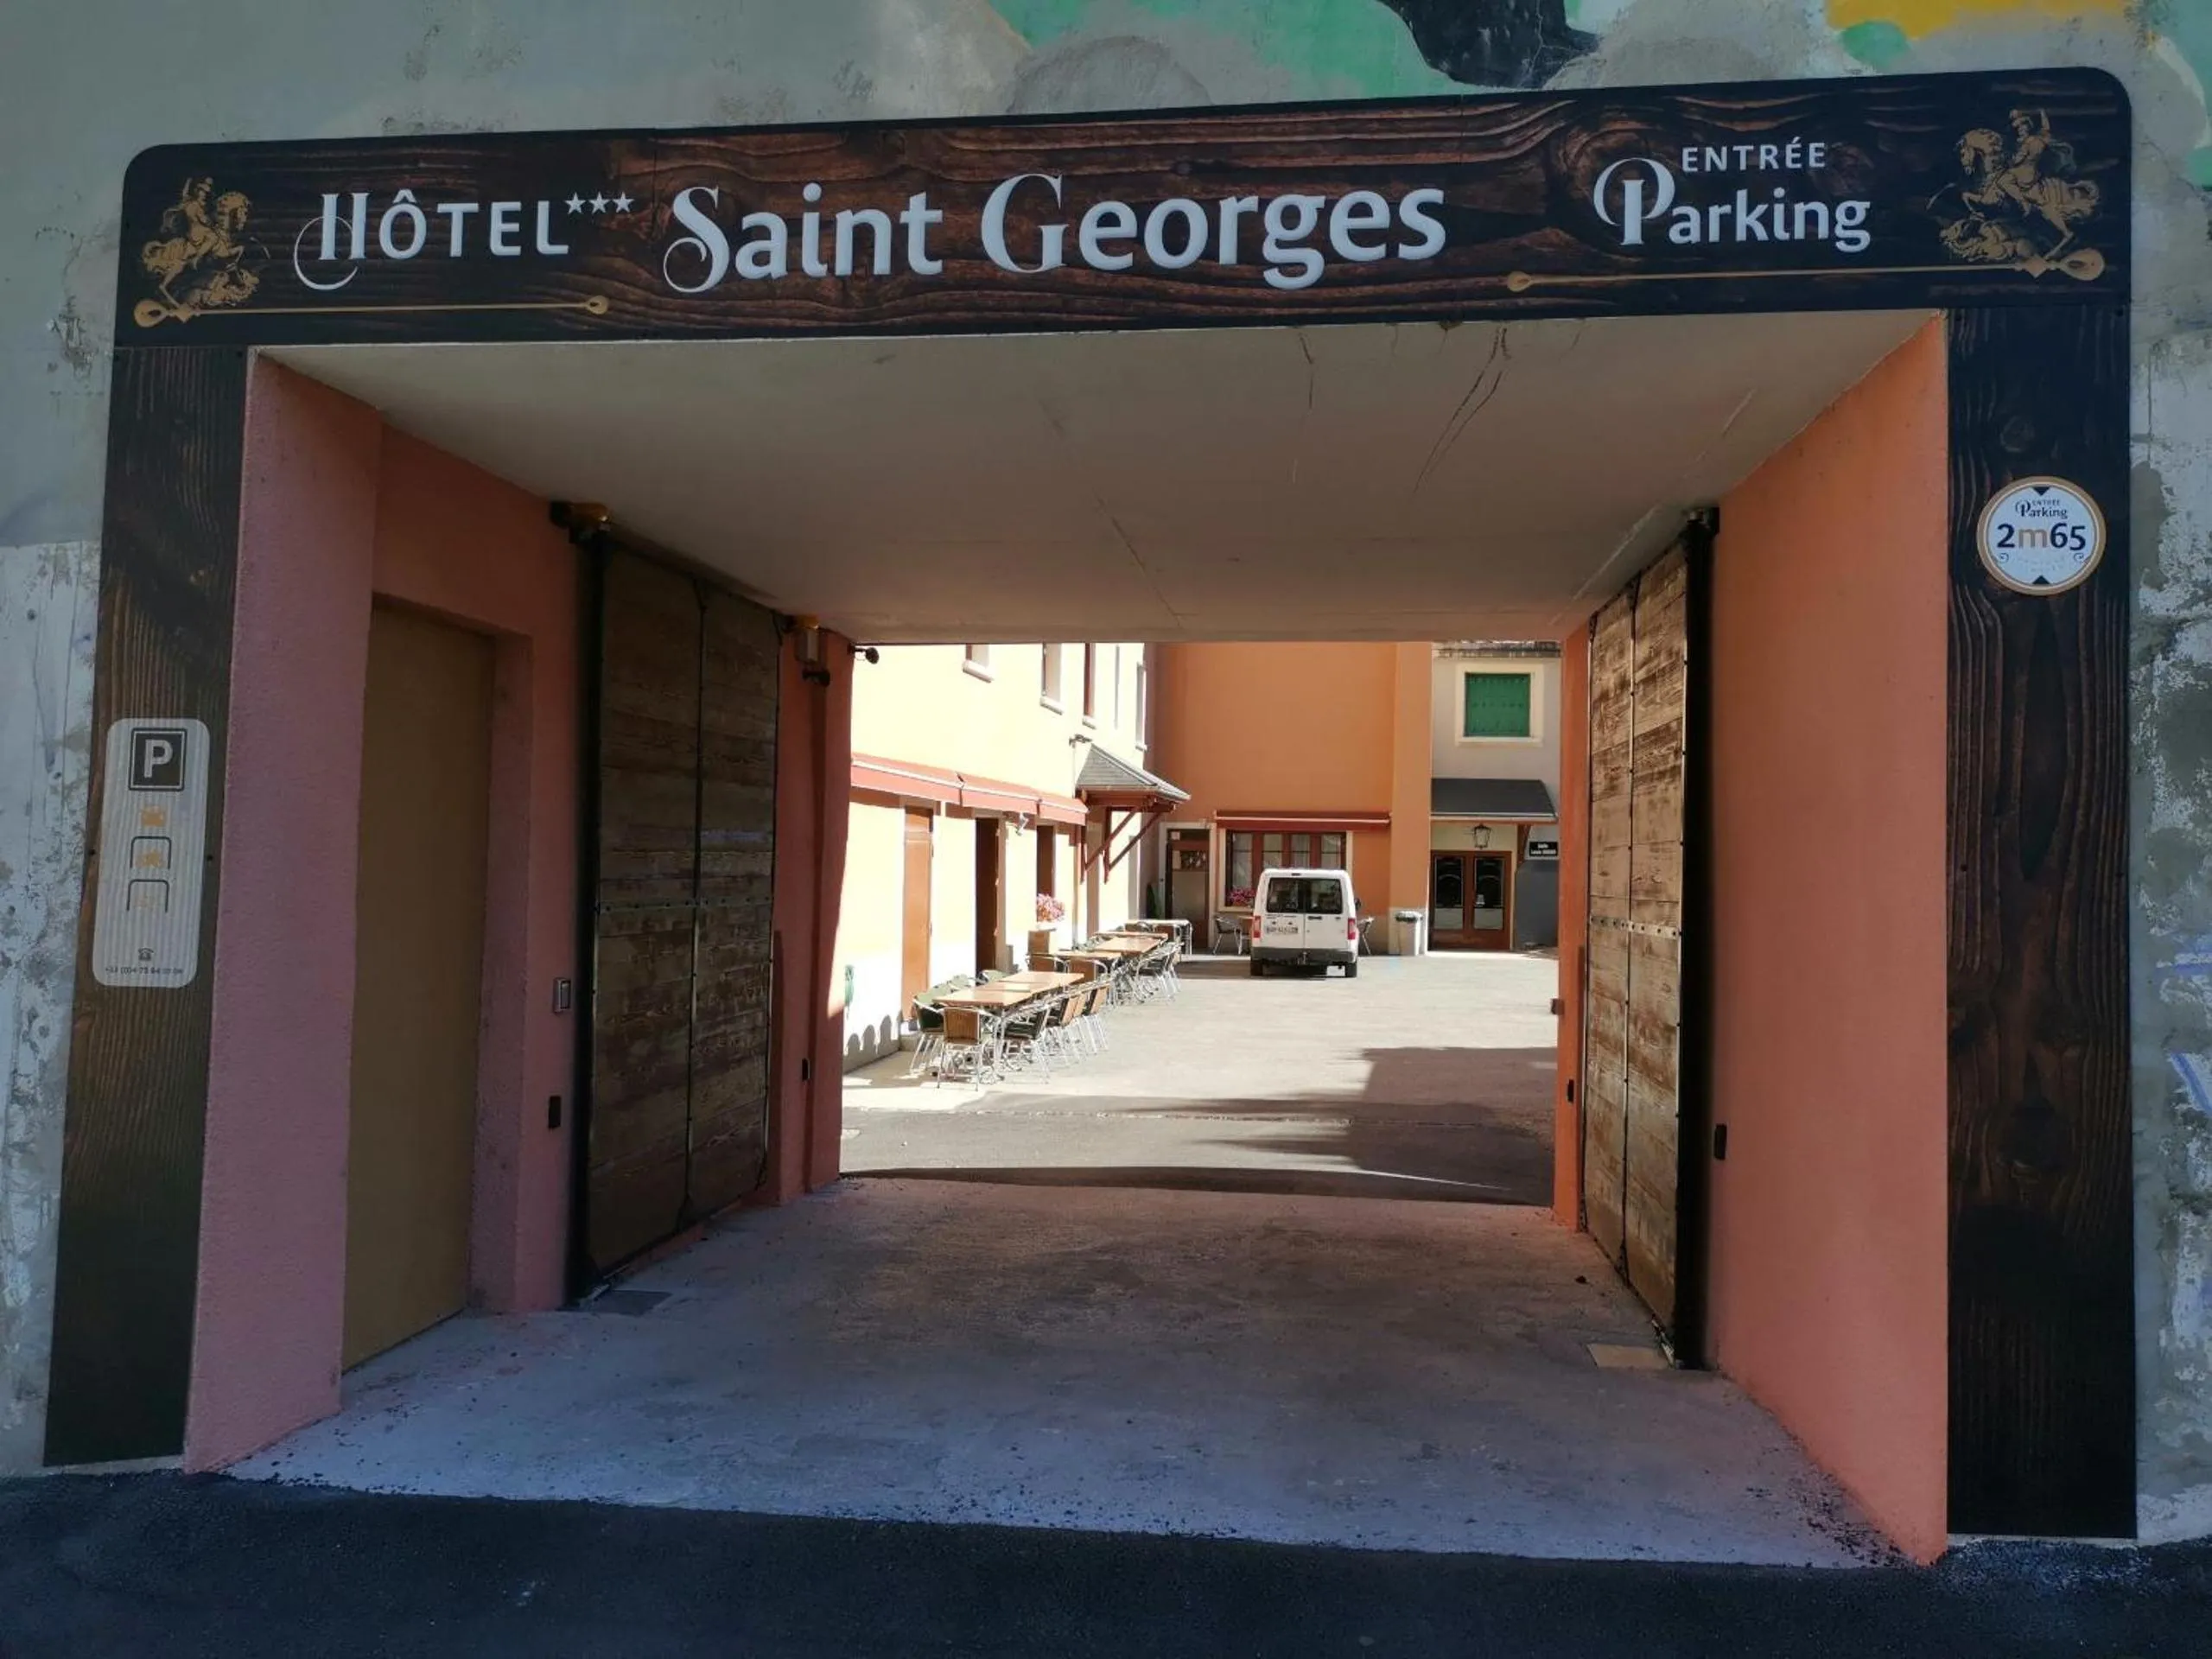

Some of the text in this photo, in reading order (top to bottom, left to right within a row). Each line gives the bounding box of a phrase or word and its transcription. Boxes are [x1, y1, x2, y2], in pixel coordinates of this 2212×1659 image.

[1681, 137, 1827, 173] ENTRÉE
[1592, 156, 1872, 252] Parking
[663, 181, 944, 294] Saint
[980, 173, 1447, 291] Georges
[2014, 499, 2069, 519] Parking
[1996, 522, 2087, 551] 2m65
[143, 739, 174, 779] P
